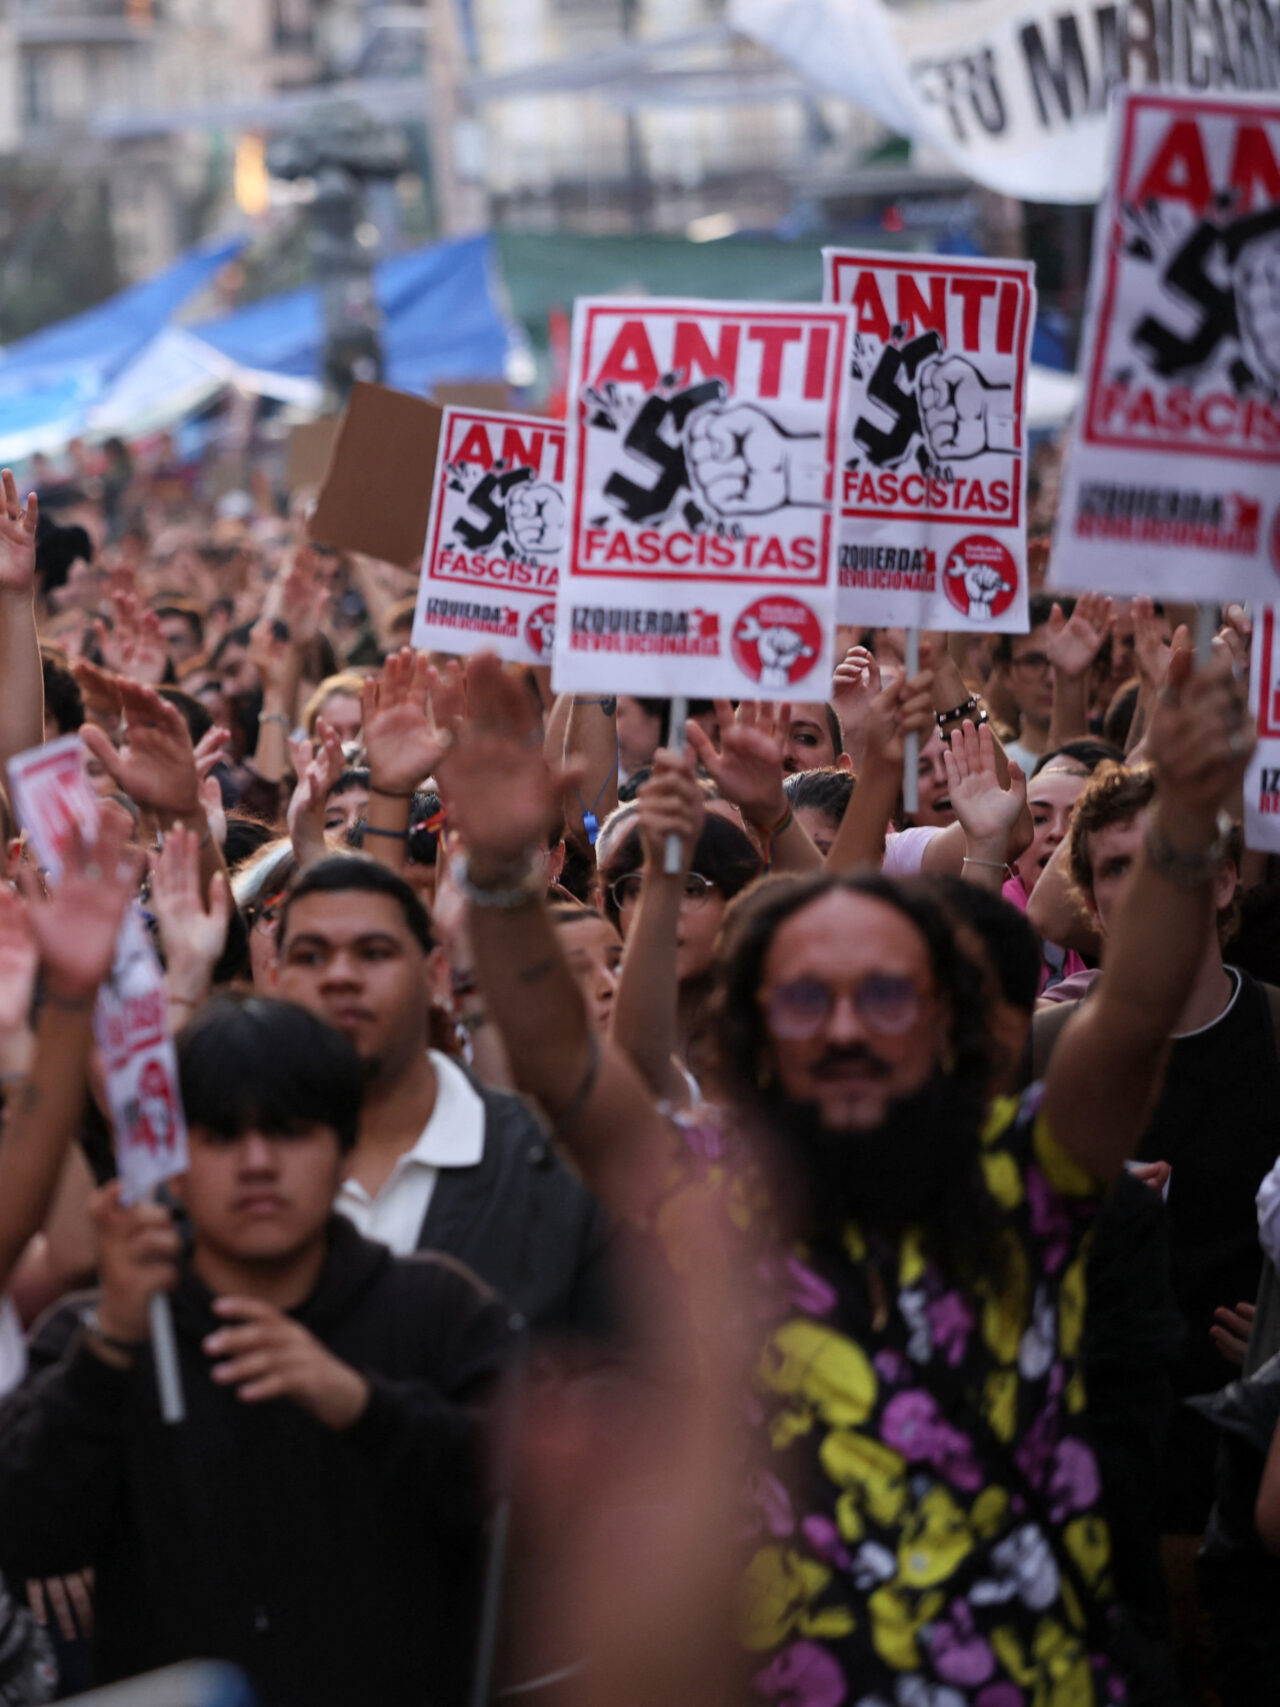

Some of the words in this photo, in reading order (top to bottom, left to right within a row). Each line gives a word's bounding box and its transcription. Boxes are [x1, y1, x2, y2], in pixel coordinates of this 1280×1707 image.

[852, 271, 1019, 355] ANTI
[593, 321, 830, 400] ANTI
[843, 470, 1010, 513] FASCISTAS
[584, 529, 818, 571] FASCISTAS
[571, 605, 689, 636] IZQUIERDA
